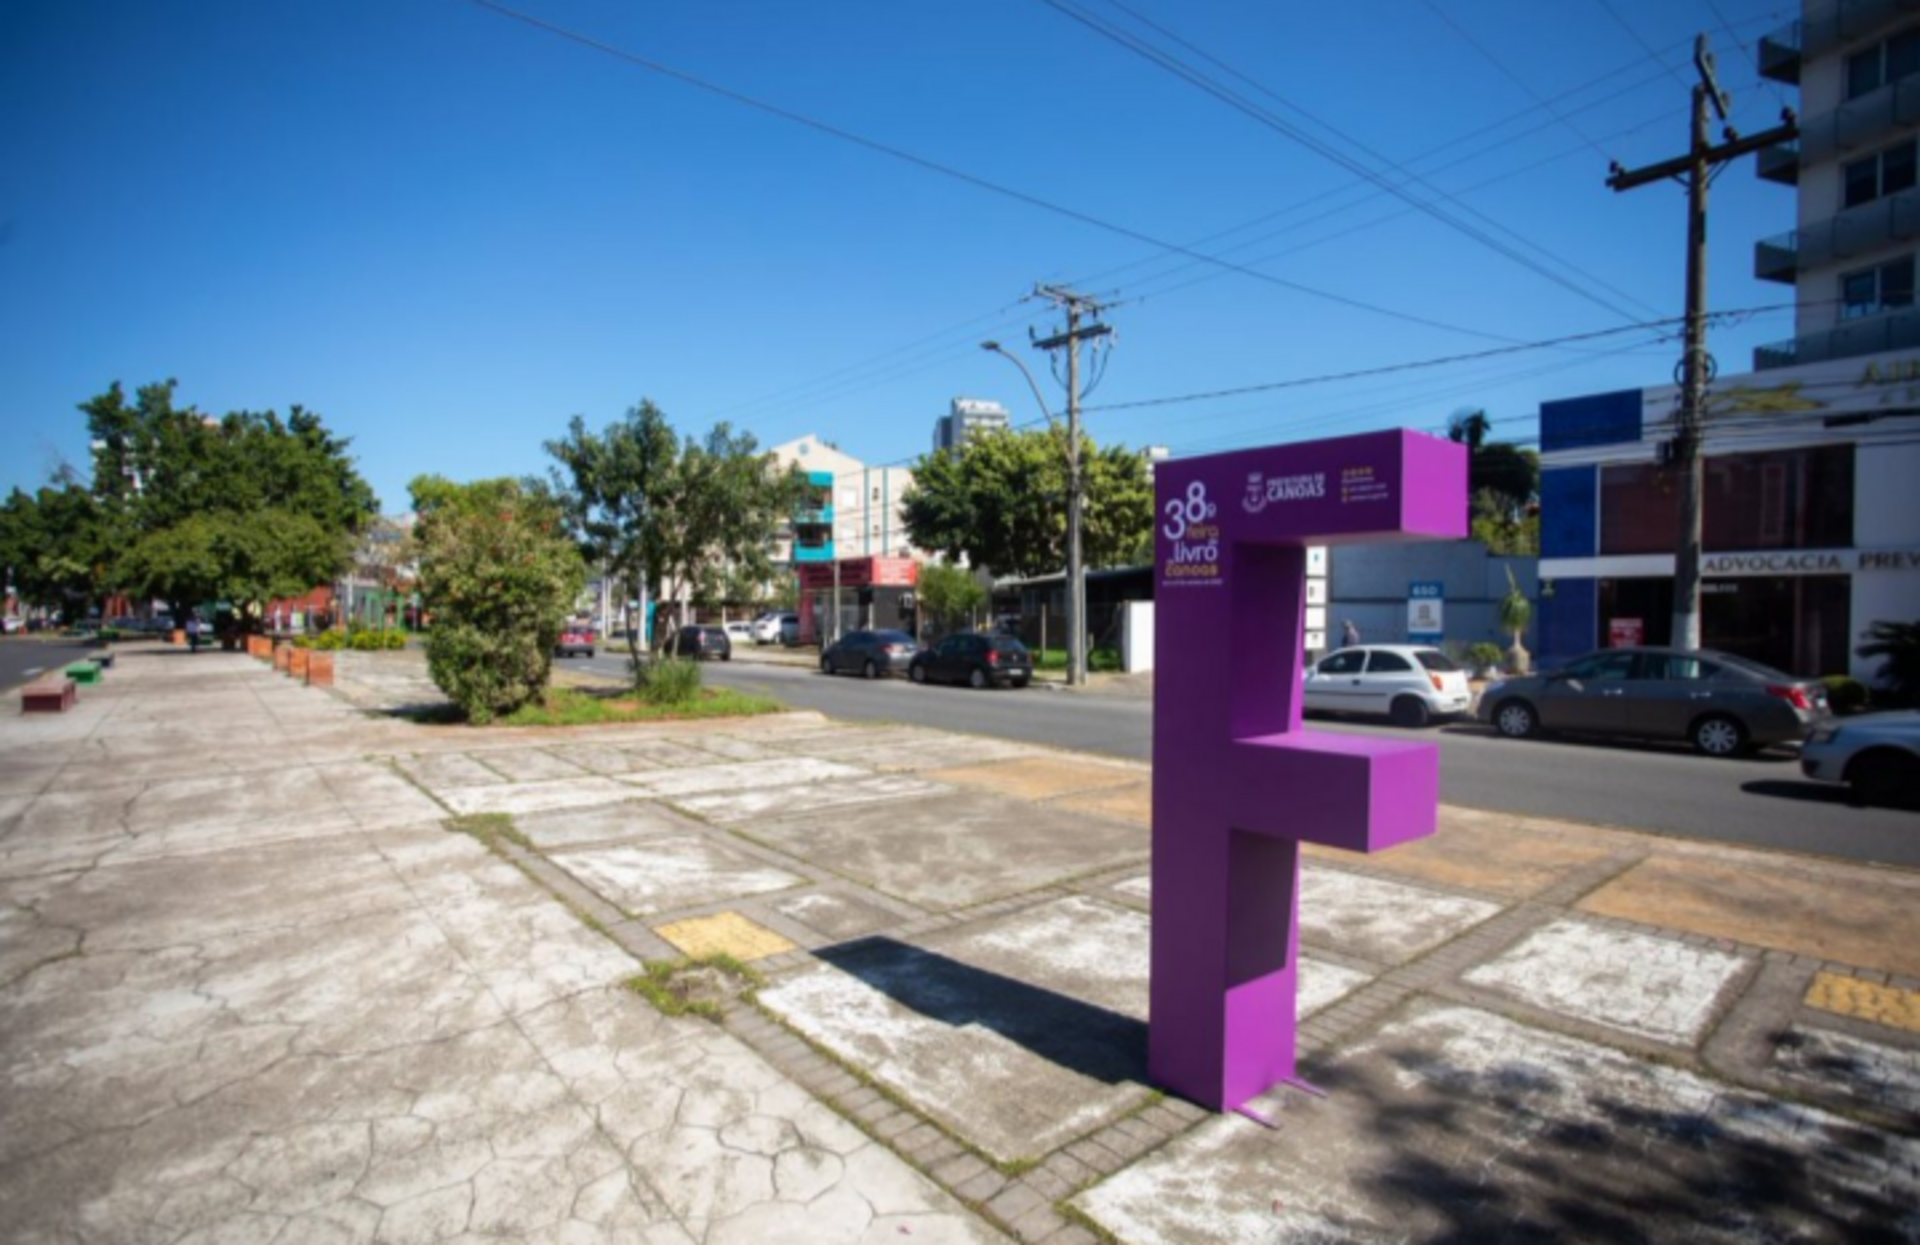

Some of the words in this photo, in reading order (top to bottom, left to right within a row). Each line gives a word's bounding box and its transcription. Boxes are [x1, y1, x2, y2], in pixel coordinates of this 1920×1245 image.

[1266, 482, 1325, 501] CANOAS
[1174, 541, 1218, 563] livro
[1704, 554, 1842, 572] ADVOCACIA
